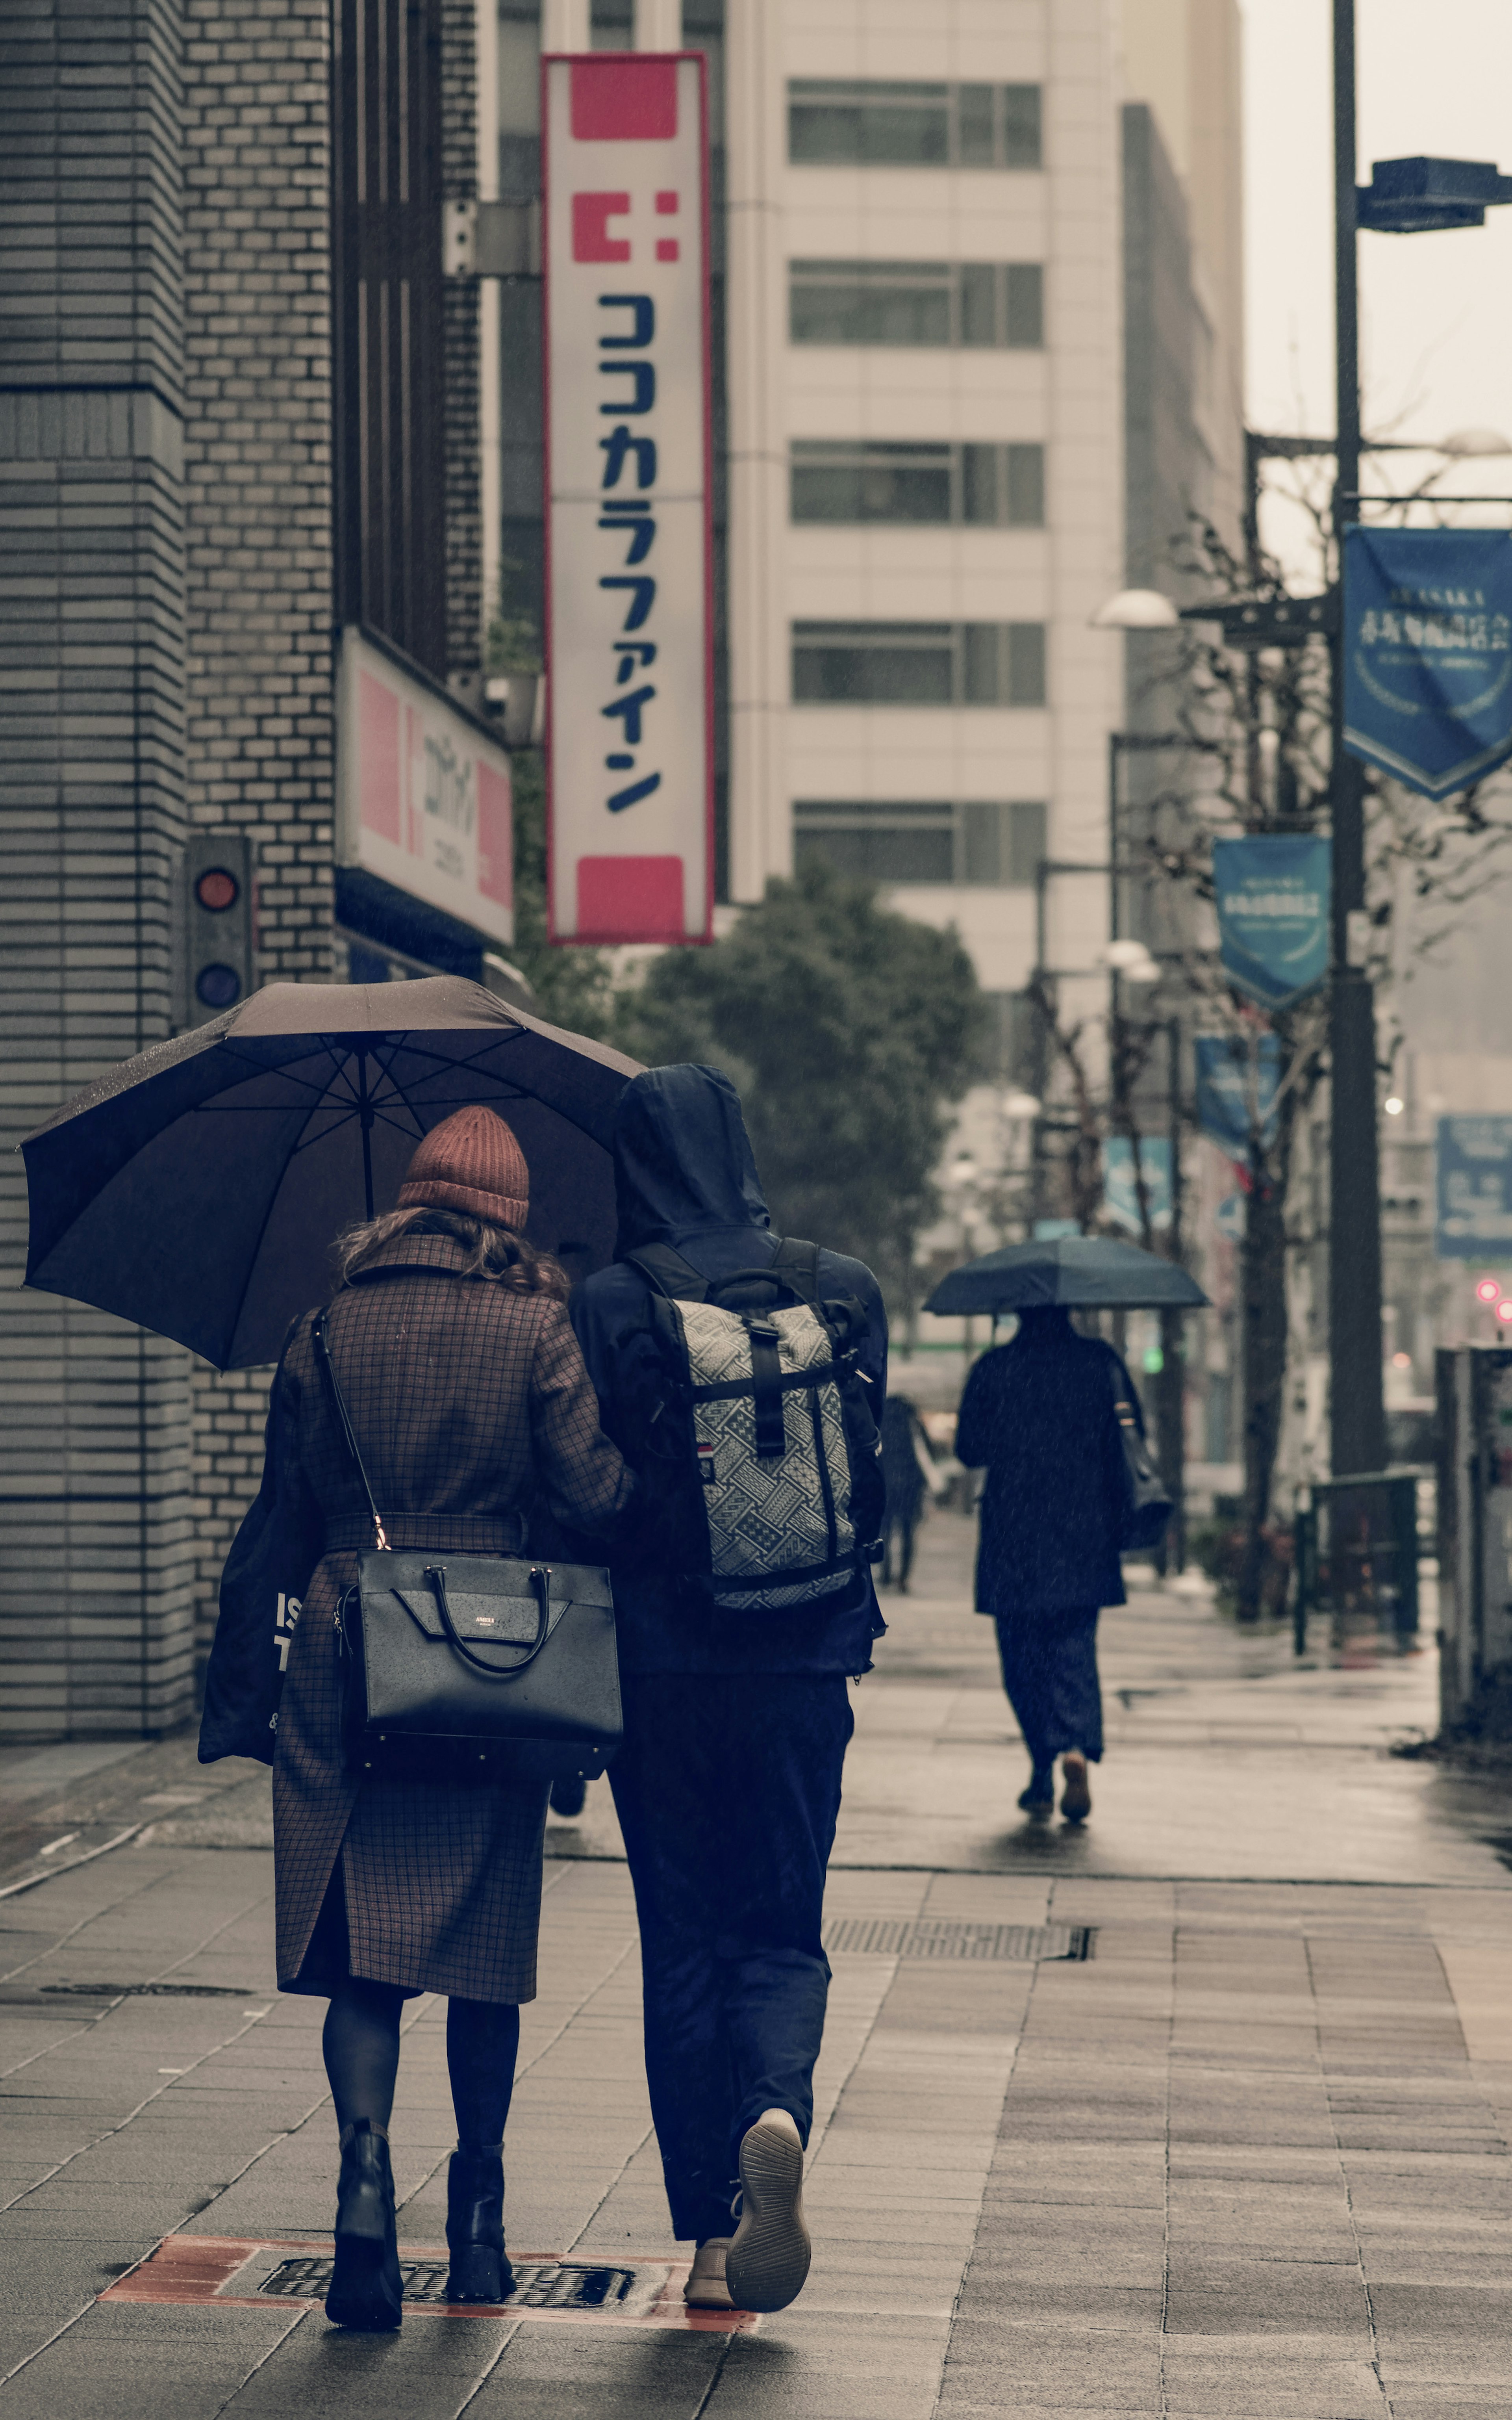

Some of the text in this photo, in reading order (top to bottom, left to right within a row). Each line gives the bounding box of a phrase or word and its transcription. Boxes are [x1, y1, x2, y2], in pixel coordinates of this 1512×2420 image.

[598, 294, 661, 813] ココカラファイン
